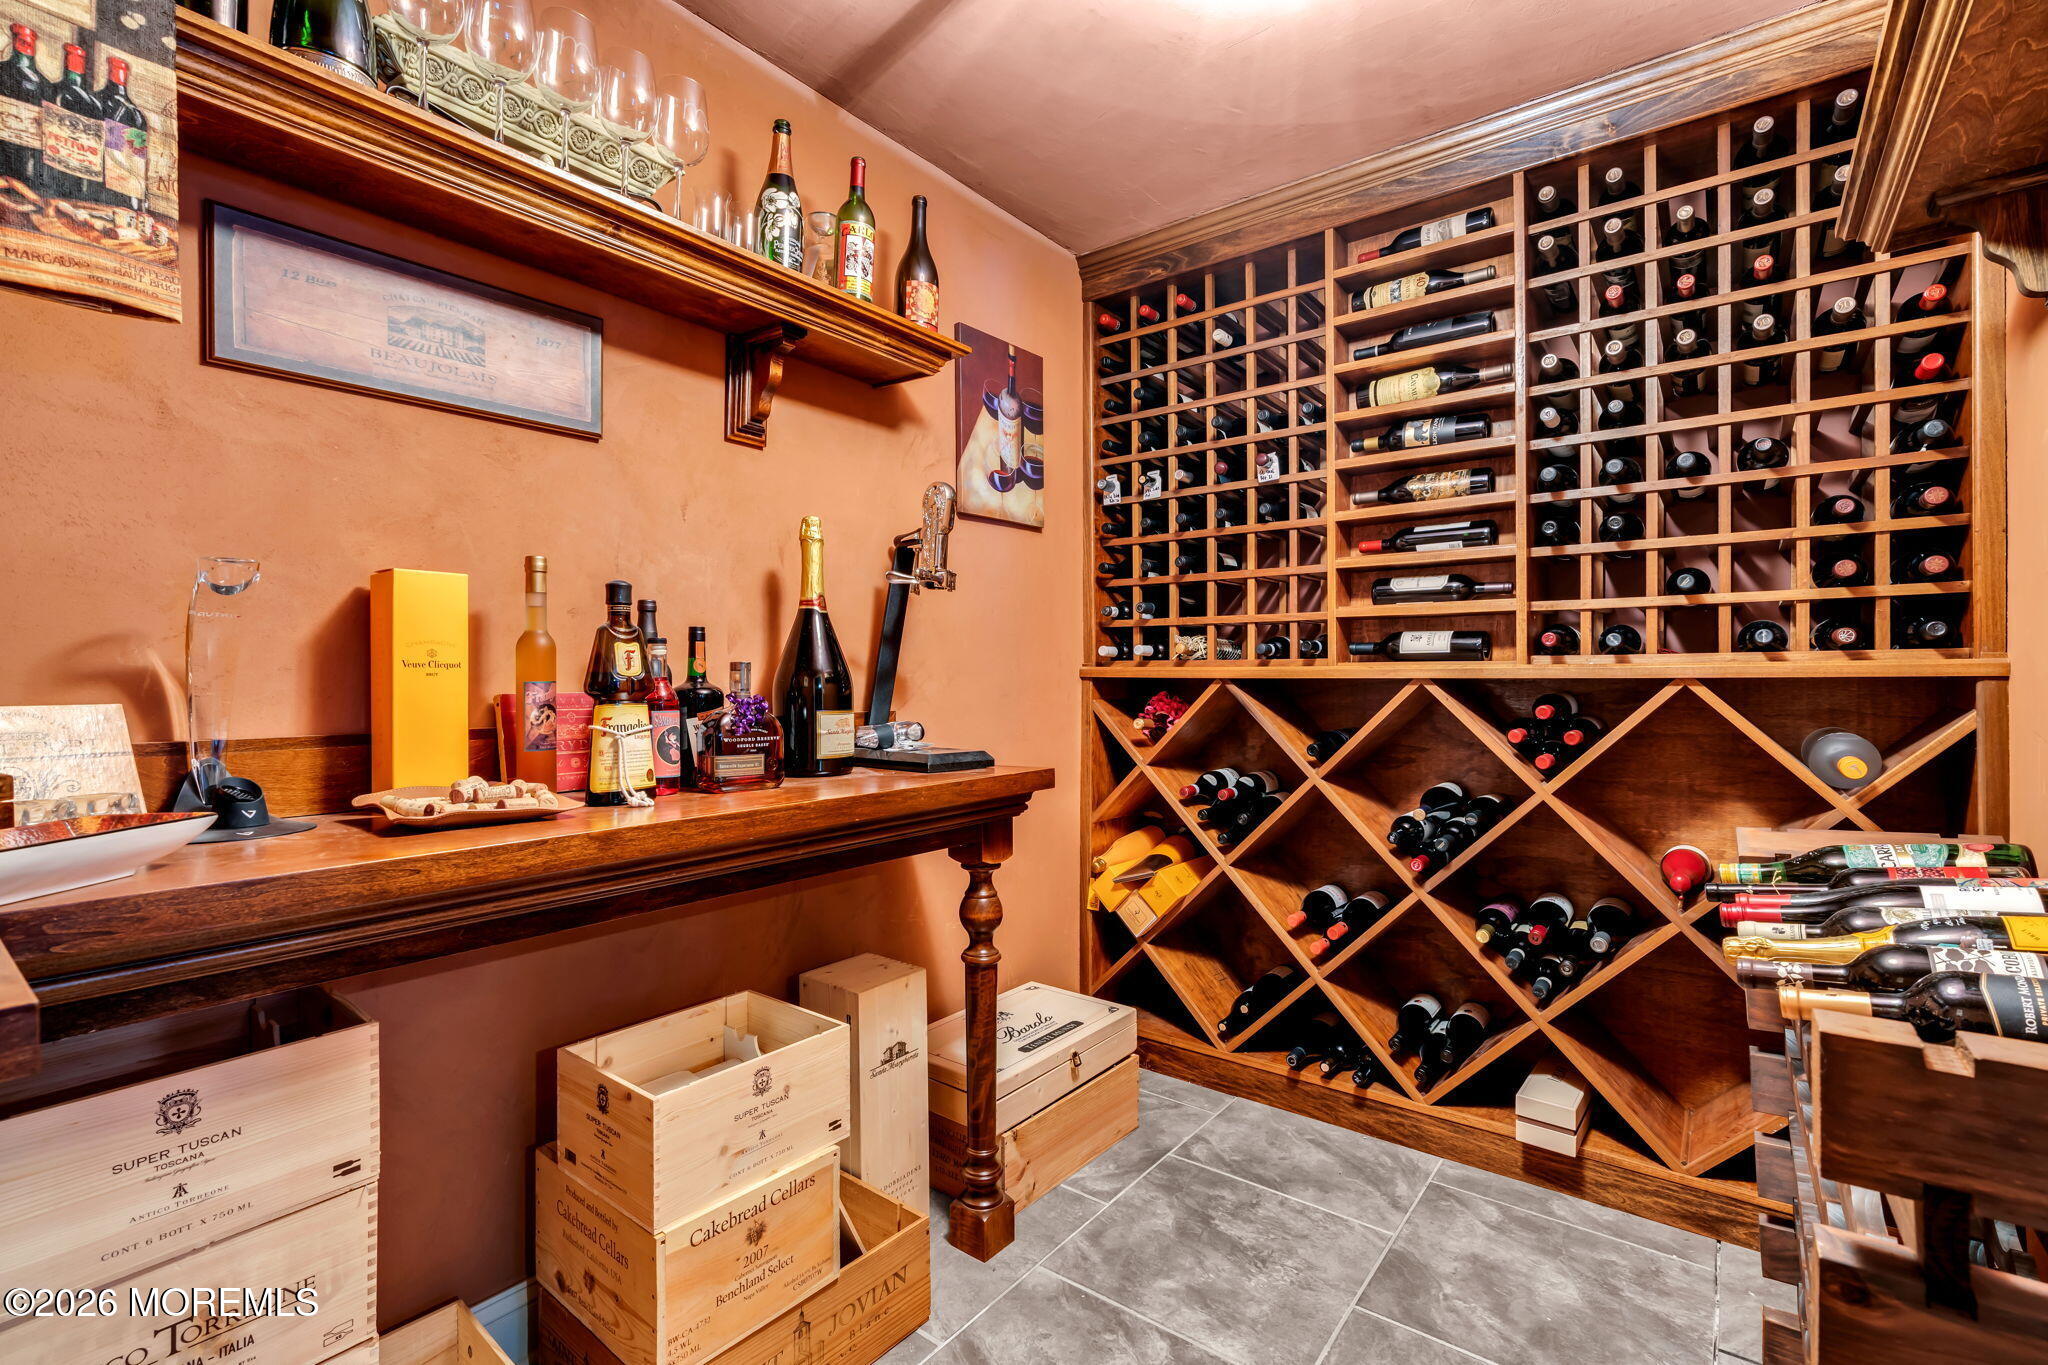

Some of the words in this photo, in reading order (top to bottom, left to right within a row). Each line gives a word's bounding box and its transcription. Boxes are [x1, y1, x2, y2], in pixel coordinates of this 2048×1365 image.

[370, 347, 498, 385] BEAUJOLAIS
[401, 659, 426, 669] Veuve
[428, 660, 462, 670] Clicquot
[996, 1012, 1053, 1045] Barolo
[2021, 995, 2038, 1035] ROBERT
[733, 1106, 760, 1123] SUPER
[761, 1092, 790, 1110] TUSCAN
[751, 1108, 774, 1122] TOSCANA
[112, 1149, 171, 1175] SUPER
[177, 1126, 243, 1154] TUSCAN
[153, 1151, 205, 1173] TOSCANA
[129, 1205, 171, 1224] ANTICO
[174, 1185, 231, 1208] TORREONE
[689, 1194, 767, 1249] Cakebread
[769, 1175, 816, 1207] Cellars
[100, 1242, 141, 1262] CONT
[145, 1237, 153, 1246] 6
[159, 1222, 193, 1241] BOTT
[212, 1208, 235, 1222] 750
[237, 1201, 254, 1213] ML
[556, 1200, 597, 1245] Cakebread
[598, 1233, 629, 1270] Cellars
[743, 1243, 769, 1269] 2007
[715, 1267, 766, 1308] Benchland
[767, 1255, 795, 1277] Select
[827, 1263, 909, 1337] JOVIAN
[218, 1334, 256, 1359] ITALIA
